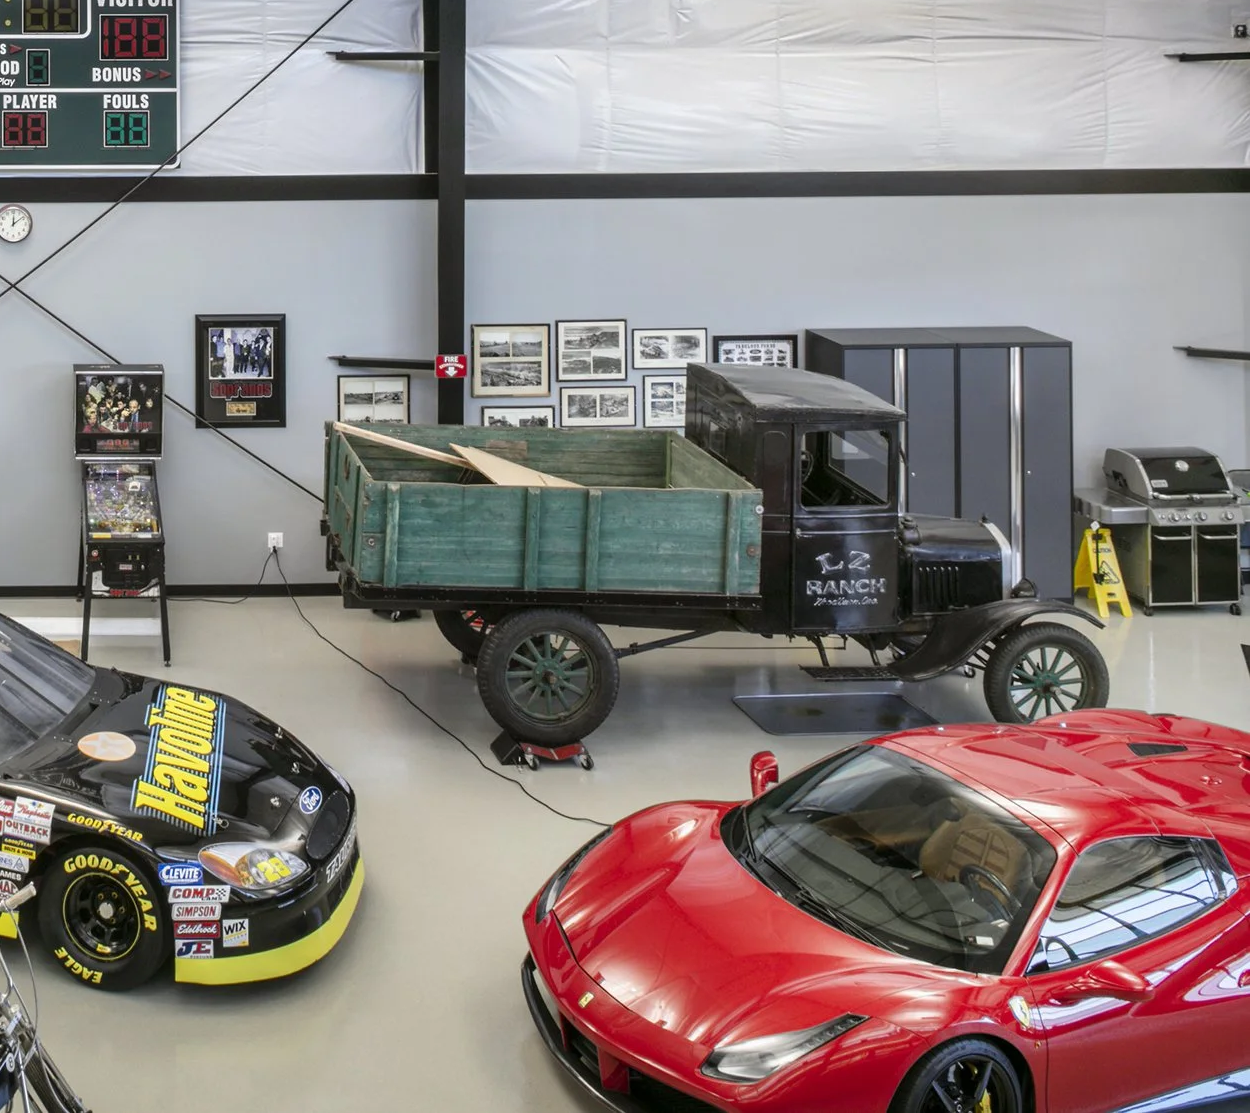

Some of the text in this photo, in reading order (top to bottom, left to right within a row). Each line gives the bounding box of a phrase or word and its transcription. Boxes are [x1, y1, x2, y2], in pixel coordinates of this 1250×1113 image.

[92, 67, 142, 82] BONUS
[2, 94, 57, 109] PLAYER
[103, 94, 149, 109] FOULS
[444, 355, 459, 363] FIRE
[806, 577, 887, 595] RANCH
[135, 686, 217, 830] Havoline
[301, 788, 321, 811] Ford
[5, 819, 49, 837] OUTBACK
[67, 813, 143, 842] GOODYEAR
[161, 864, 200, 880] CLEVITE
[256, 856, 293, 883] 28
[64, 854, 158, 933] GOODYEAR
[171, 887, 216, 899] COMP
[175, 905, 217, 918] SIMPSON
[176, 923, 218, 935] Edelbrock
[223, 920, 247, 935] WIX
[177, 941, 212, 957] JE
[54, 946, 104, 985] EAGLE
